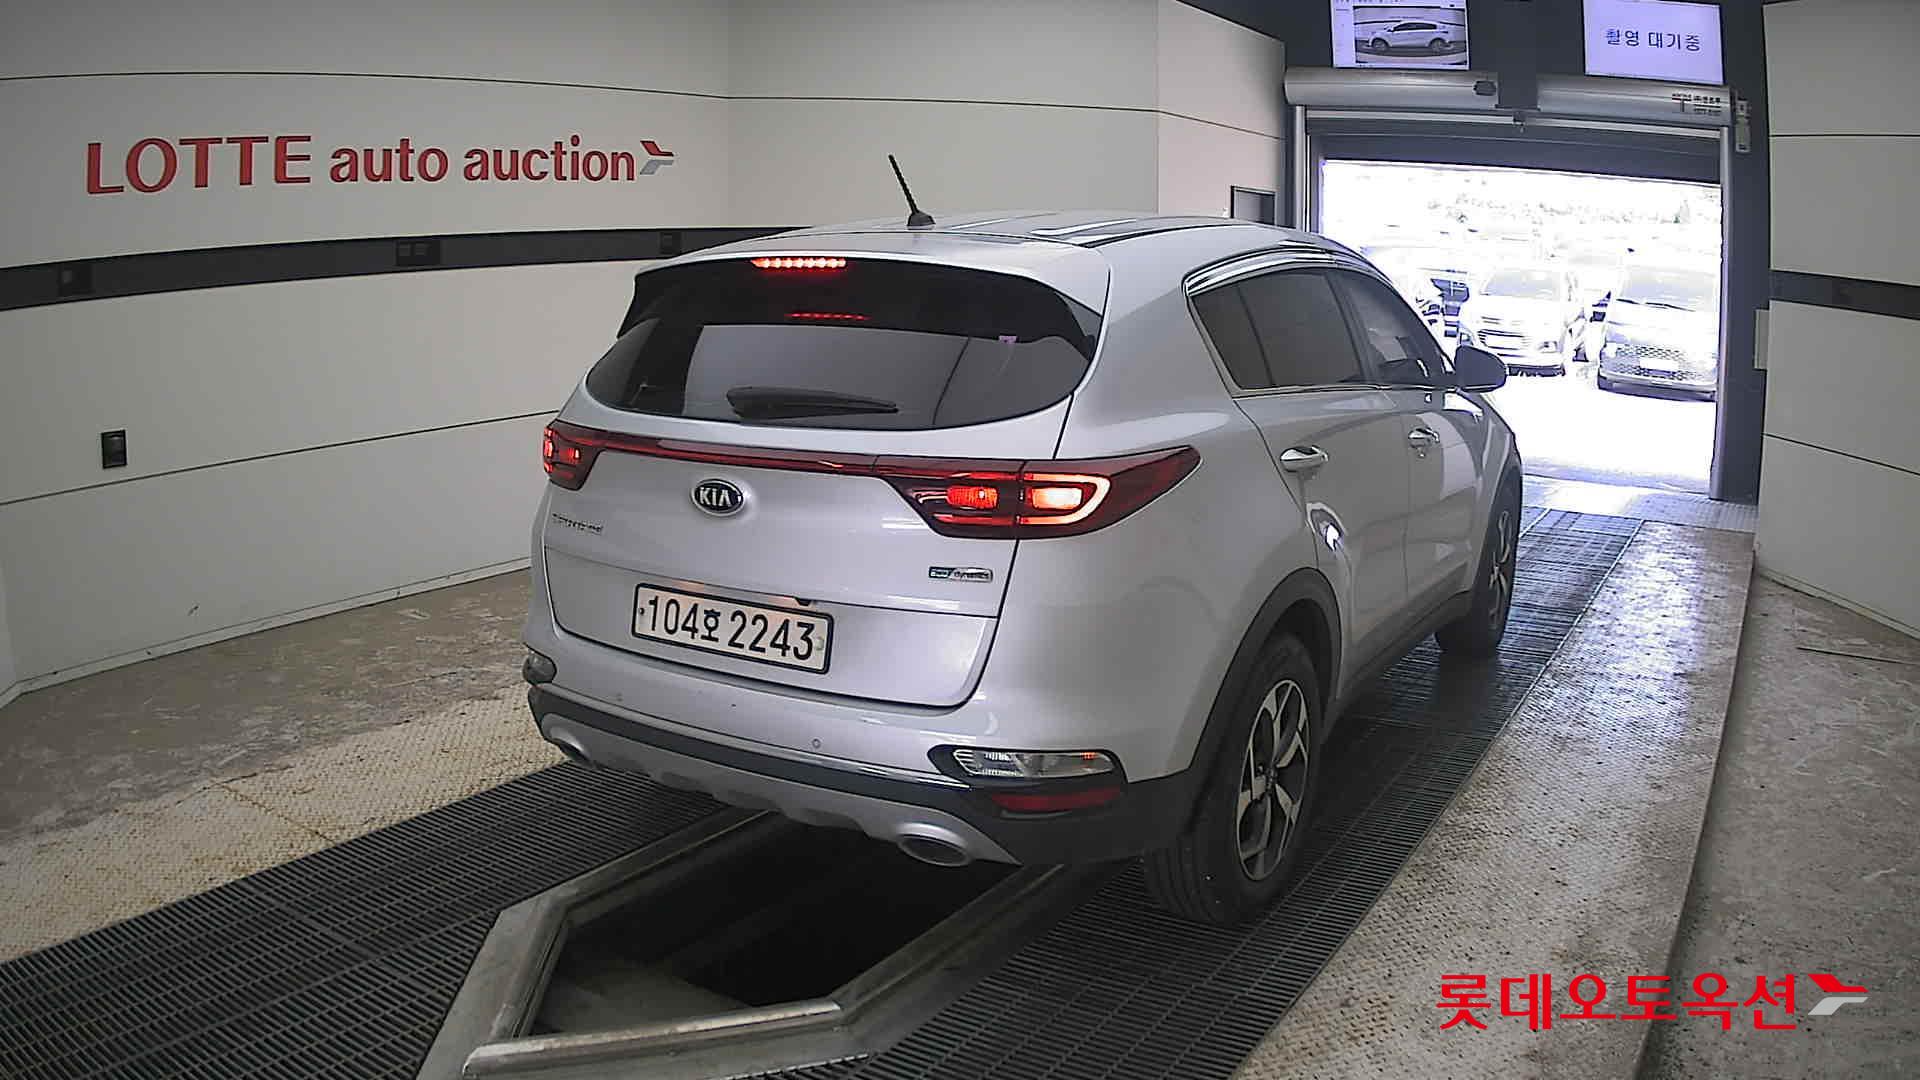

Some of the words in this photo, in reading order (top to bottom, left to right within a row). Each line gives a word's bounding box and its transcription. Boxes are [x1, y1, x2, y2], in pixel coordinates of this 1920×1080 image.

[1648, 31, 1701, 52] 대기중
[86, 135, 312, 195] LOTTE
[330, 138, 449, 183] auto
[463, 134, 636, 182] auction
[700, 486, 731, 507] KIA
[649, 595, 721, 643] 104호
[727, 609, 815, 661] 2243
